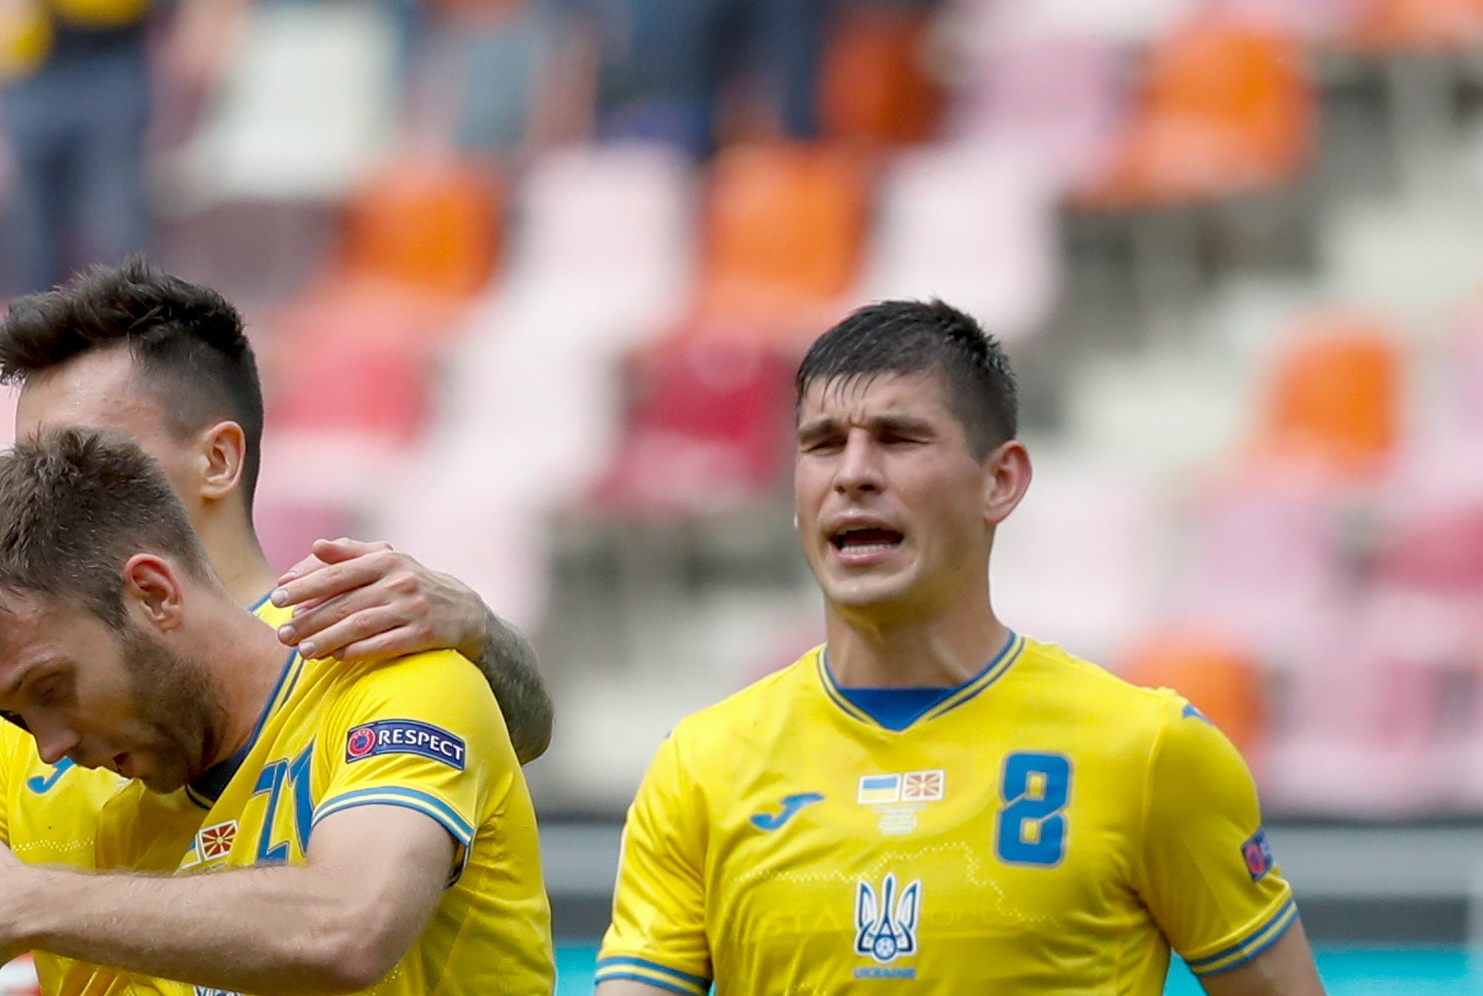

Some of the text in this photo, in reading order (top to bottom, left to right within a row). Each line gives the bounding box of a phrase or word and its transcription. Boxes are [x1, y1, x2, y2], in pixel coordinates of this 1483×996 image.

[251, 735, 316, 868] 21
[378, 728, 464, 760] RESPECT
[993, 749, 1075, 870] 8
